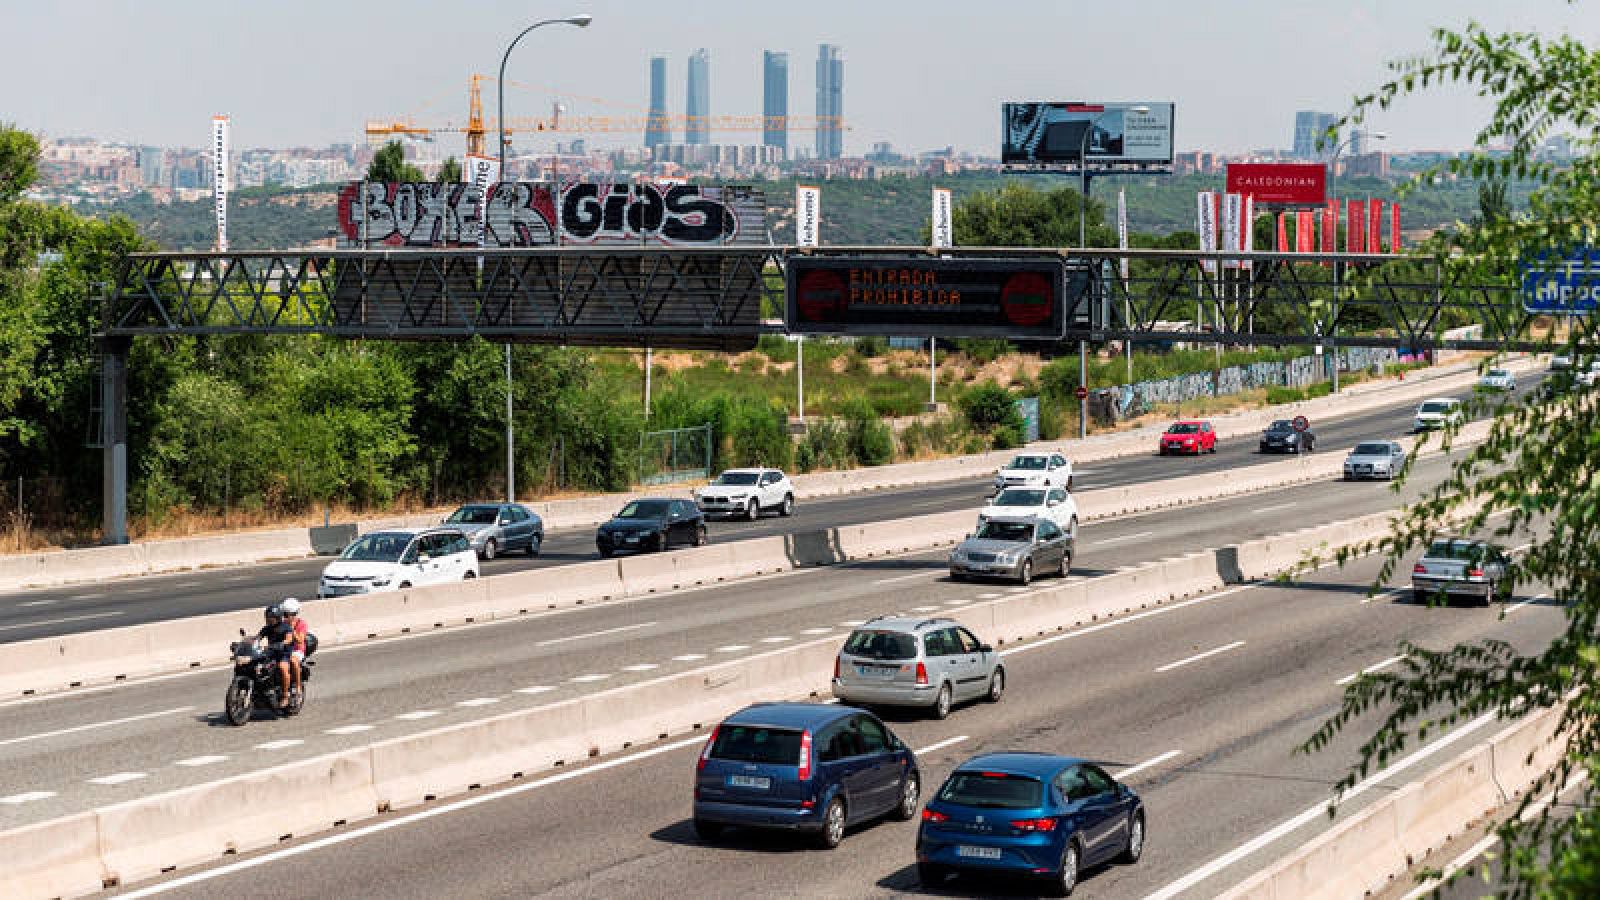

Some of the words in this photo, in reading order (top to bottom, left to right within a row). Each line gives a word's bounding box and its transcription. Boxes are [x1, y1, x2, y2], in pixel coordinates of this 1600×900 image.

[1236, 176, 1316, 187] CALEDONIAN
[850, 268, 937, 285] ENTRADA
[850, 288, 961, 304] PROHIBIDA
